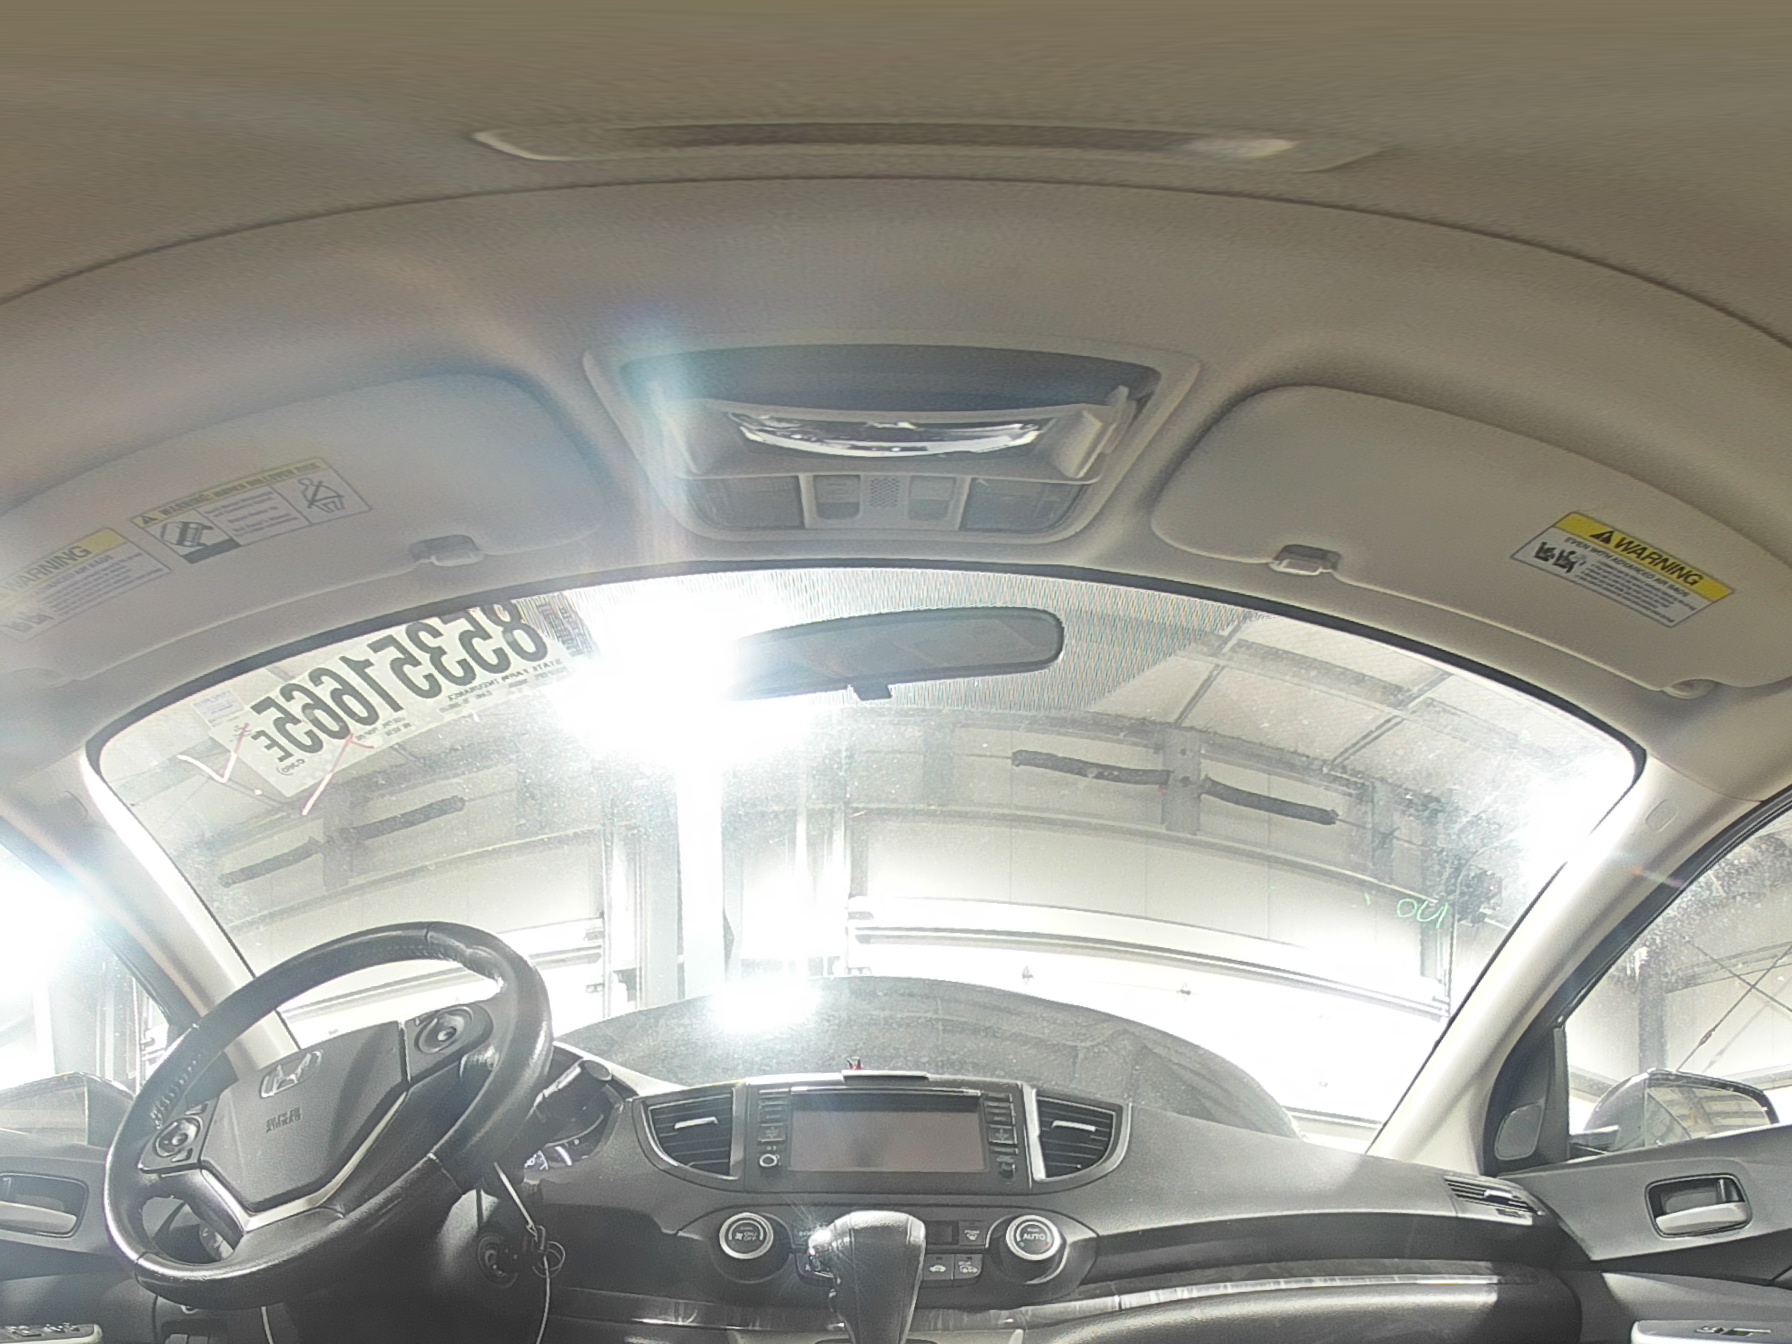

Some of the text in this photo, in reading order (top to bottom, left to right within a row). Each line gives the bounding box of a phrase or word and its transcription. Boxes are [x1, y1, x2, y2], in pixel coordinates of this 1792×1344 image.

[0, 545, 92, 598] WARNING
[1611, 553, 1654, 580] ADVANCED
[1614, 537, 1704, 586] WARNING
[1022, 1233, 1046, 1241] AUTO
